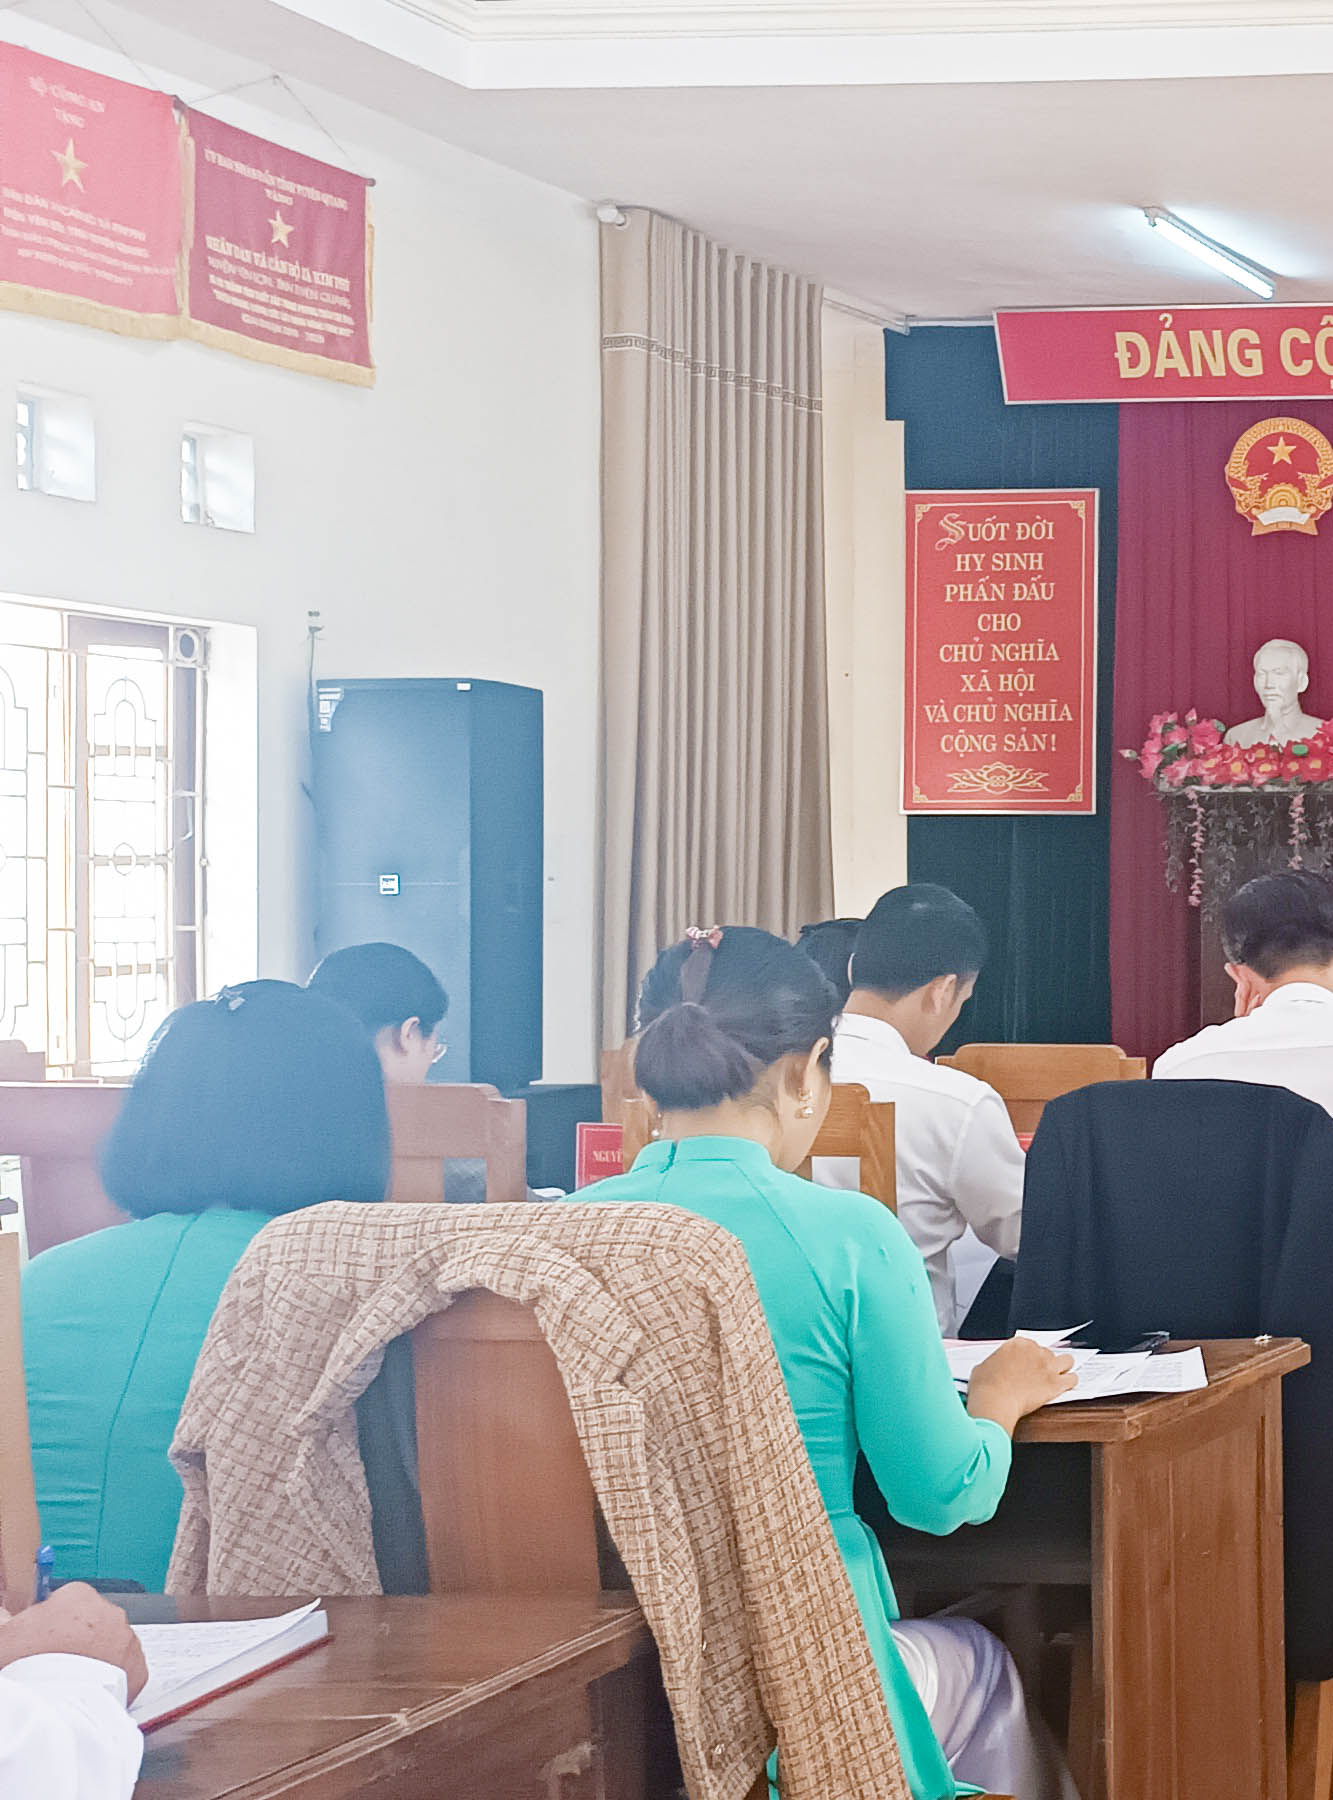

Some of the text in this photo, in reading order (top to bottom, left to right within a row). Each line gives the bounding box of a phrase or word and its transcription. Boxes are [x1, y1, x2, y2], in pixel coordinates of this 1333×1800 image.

[1114, 311, 1263, 378] ĐẢNG
[936, 513, 1054, 550] SUỐT ĐỜI
[956, 553, 1043, 571] HY SINH
[945, 575, 1054, 602] PHẤN ĐẤU
[978, 613, 1021, 631] CHO
[940, 637, 1059, 662] CHỦ NGHĨA
[961, 668, 1034, 696] XÃ HỘI
[924, 697, 1072, 722] VÀ CHỦ NGHĨA
[941, 729, 997, 757] CỘNG
